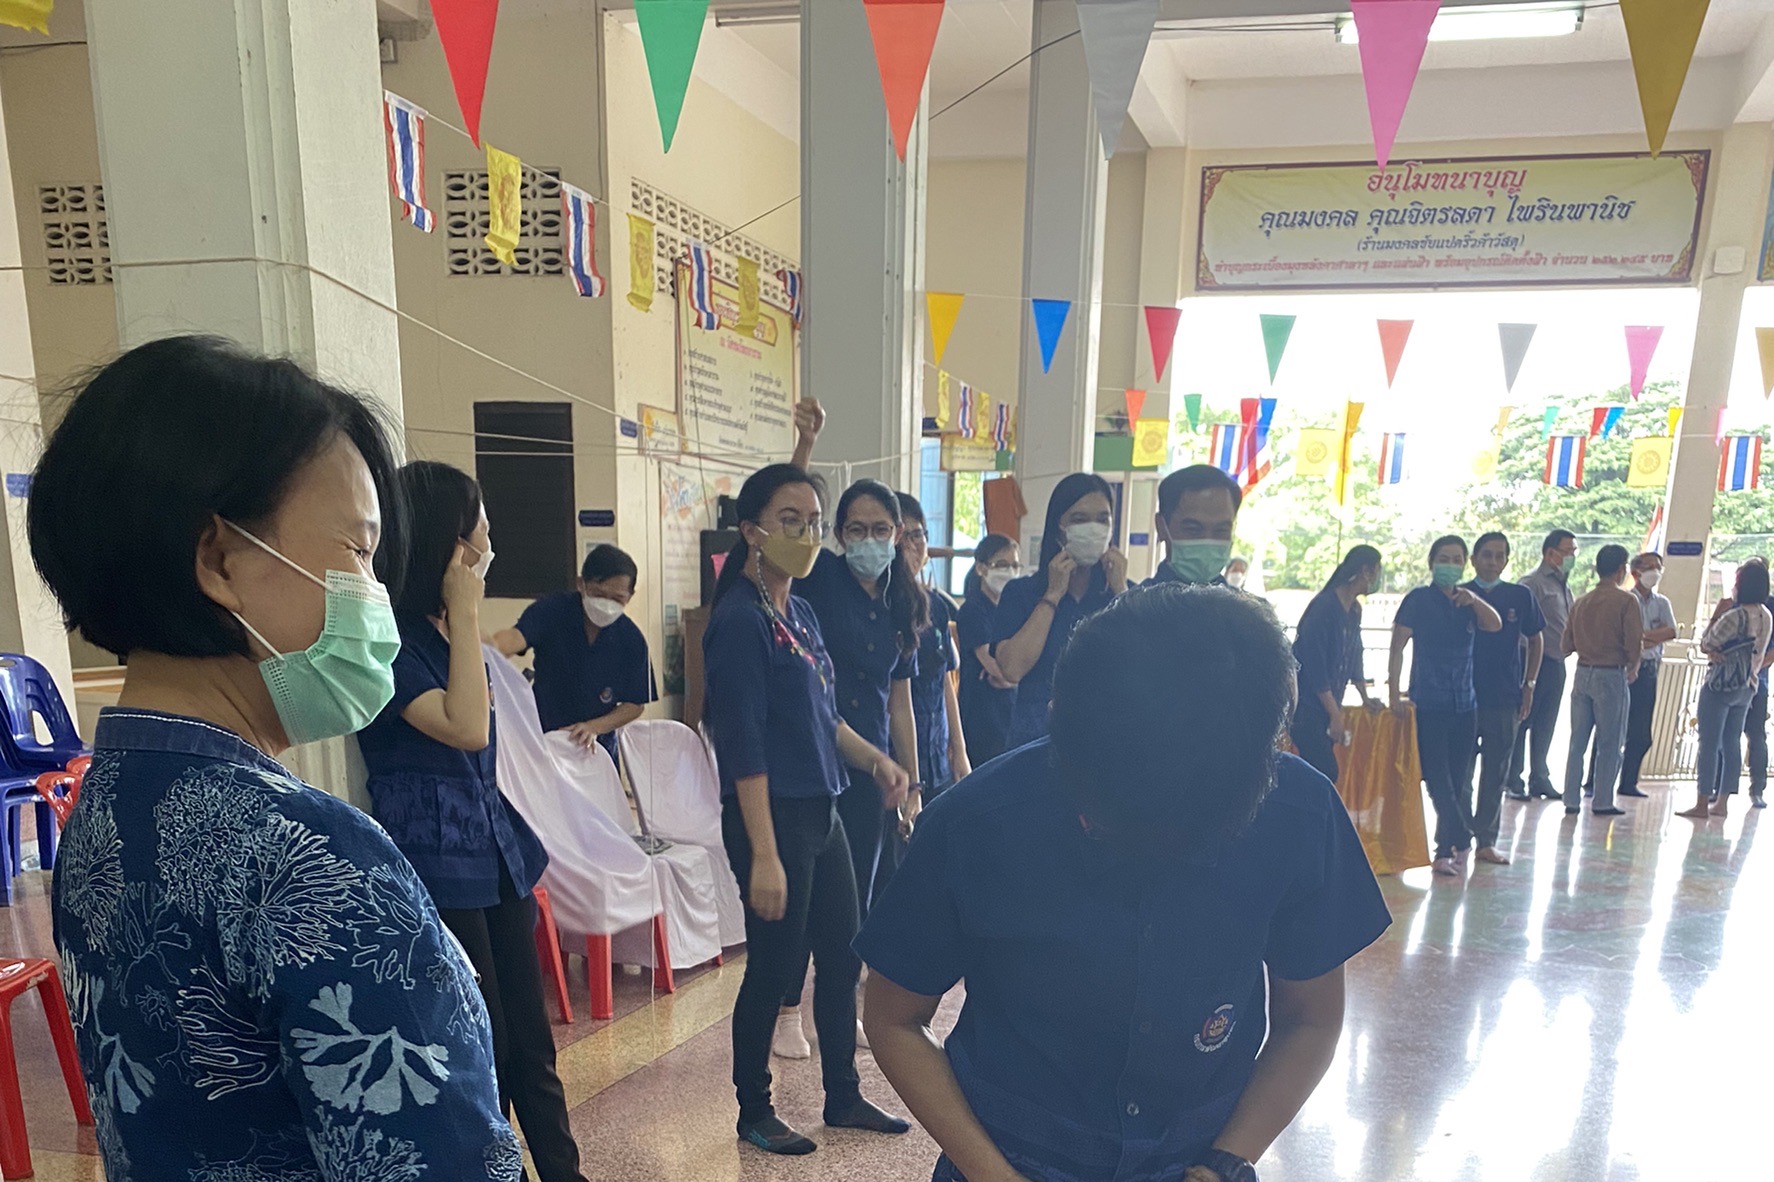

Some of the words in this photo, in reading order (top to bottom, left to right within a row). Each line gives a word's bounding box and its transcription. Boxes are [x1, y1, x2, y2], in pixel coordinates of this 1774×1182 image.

[1367, 161, 1527, 201] อนุโมทนาบุญ
[1258, 208, 1359, 237] คุณมงคล
[1367, 201, 1496, 235] คุณจิตรลดา
[1506, 195, 1636, 225] ไพรินพานิช
